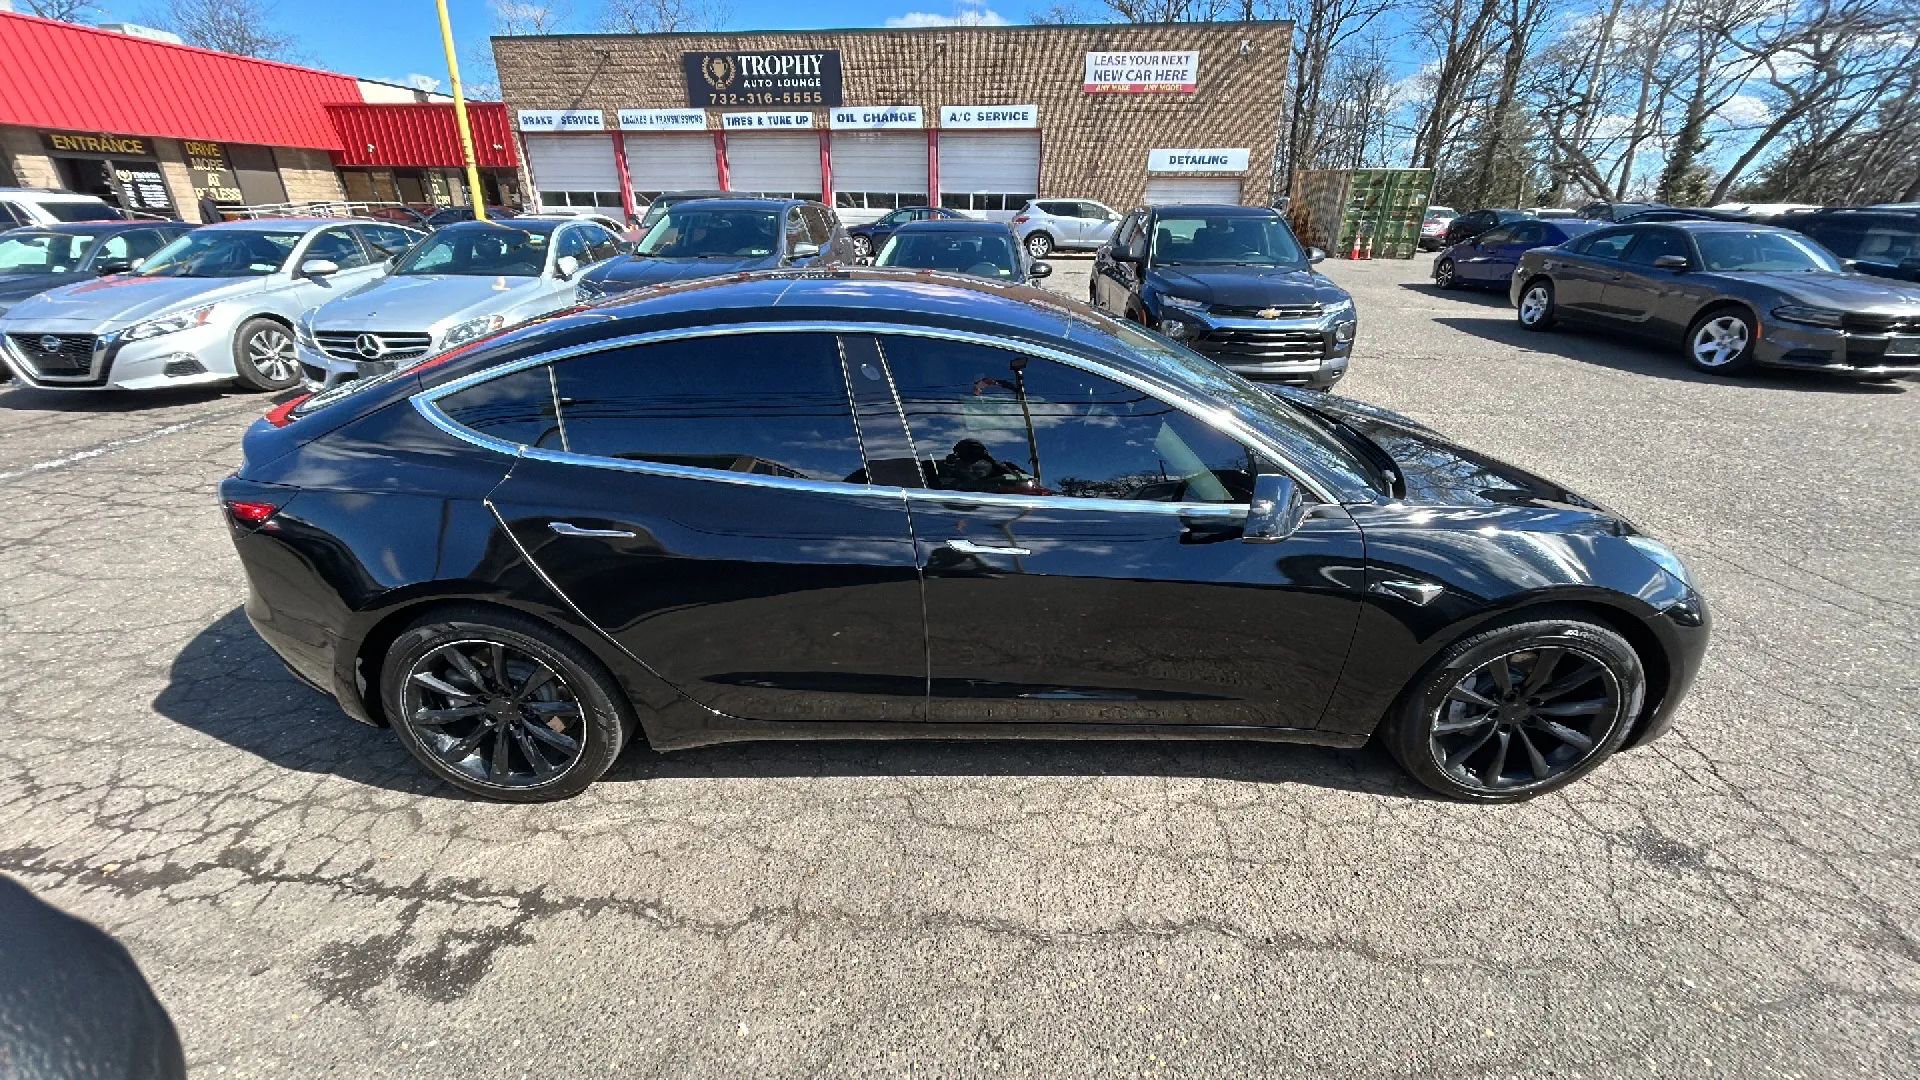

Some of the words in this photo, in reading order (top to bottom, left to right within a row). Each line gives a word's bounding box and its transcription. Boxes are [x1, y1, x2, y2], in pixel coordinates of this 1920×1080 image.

[738, 53, 824, 76] TROPHY
[1094, 56, 1127, 66] LEASE
[1130, 55, 1159, 66] YOUR
[1162, 55, 1190, 65] NEXT
[1094, 70, 1123, 82] NEW
[1126, 70, 1152, 82] CAR
[1155, 69, 1188, 81] HERE
[743, 79, 773, 88] AUTO
[777, 77, 821, 88] LOUNGE
[709, 92, 823, 105] 732-316-5555
[522, 116, 553, 125] BRAKE
[561, 115, 600, 125] SERVICE
[726, 117, 753, 127] TIRES
[757, 117, 764, 126] &
[768, 116, 792, 125] TUNE
[796, 115, 809, 124] UP
[837, 113, 857, 123] OIL
[863, 112, 917, 123] CHANGE
[949, 112, 971, 122] A/C
[977, 111, 1029, 121] SERVICE
[51, 134, 146, 155] ENTRANCE
[184, 141, 220, 156] DRIVE
[191, 157, 226, 171] MORE
[1169, 155, 1229, 165] DETAILING
[207, 173, 221, 187] AT
